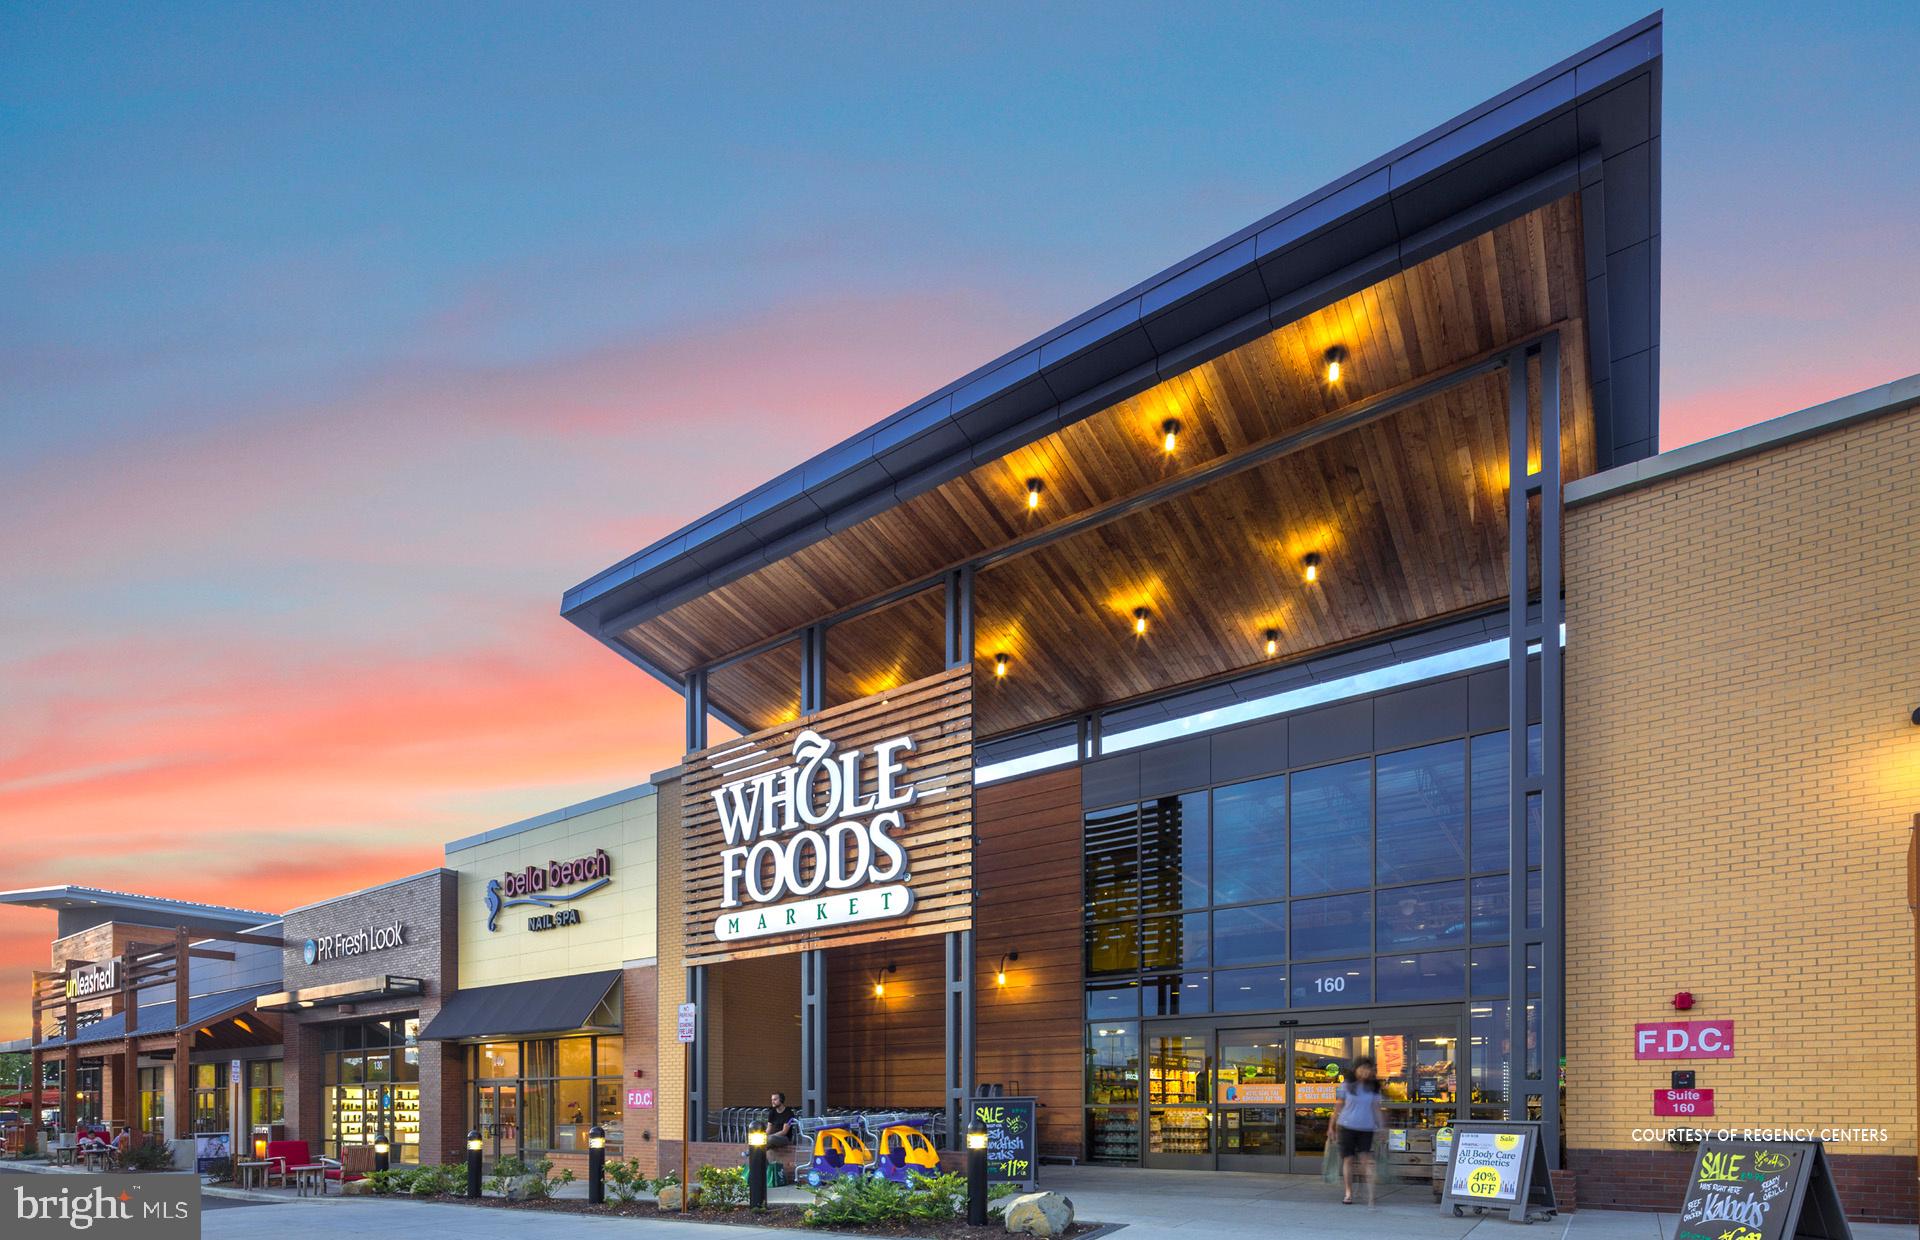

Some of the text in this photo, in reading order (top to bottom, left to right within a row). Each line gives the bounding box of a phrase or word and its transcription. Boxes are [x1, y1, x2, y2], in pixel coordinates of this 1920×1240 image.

[710, 729, 915, 845] WHOLE
[720, 811, 906, 909] FOODS
[505, 848, 610, 897] bella beach
[528, 909, 579, 931] NAIL SPA
[728, 892, 893, 934] MARKET
[318, 936, 333, 960] PR
[335, 928, 369, 958] Fresh
[370, 920, 403, 950] Look
[1315, 976, 1345, 993] 160
[1639, 1027, 1731, 1053] F.D.C.
[628, 1093, 653, 1105] F.D.C.
[1667, 1090, 1700, 1101] Suite
[976, 1106, 1005, 1123] SALE
[1672, 1103, 1695, 1113] 160
[1458, 1149, 1516, 1160] All Body Care
[1467, 1157, 1511, 1168] Cosmetics
[1699, 1151, 1746, 1181] SALE
[1472, 1171, 1497, 1182] 40%
[1470, 1182, 1497, 1195] OFF
[1727, 1186, 1743, 1195] HERE
[1702, 1192, 1770, 1228] Kabobs
